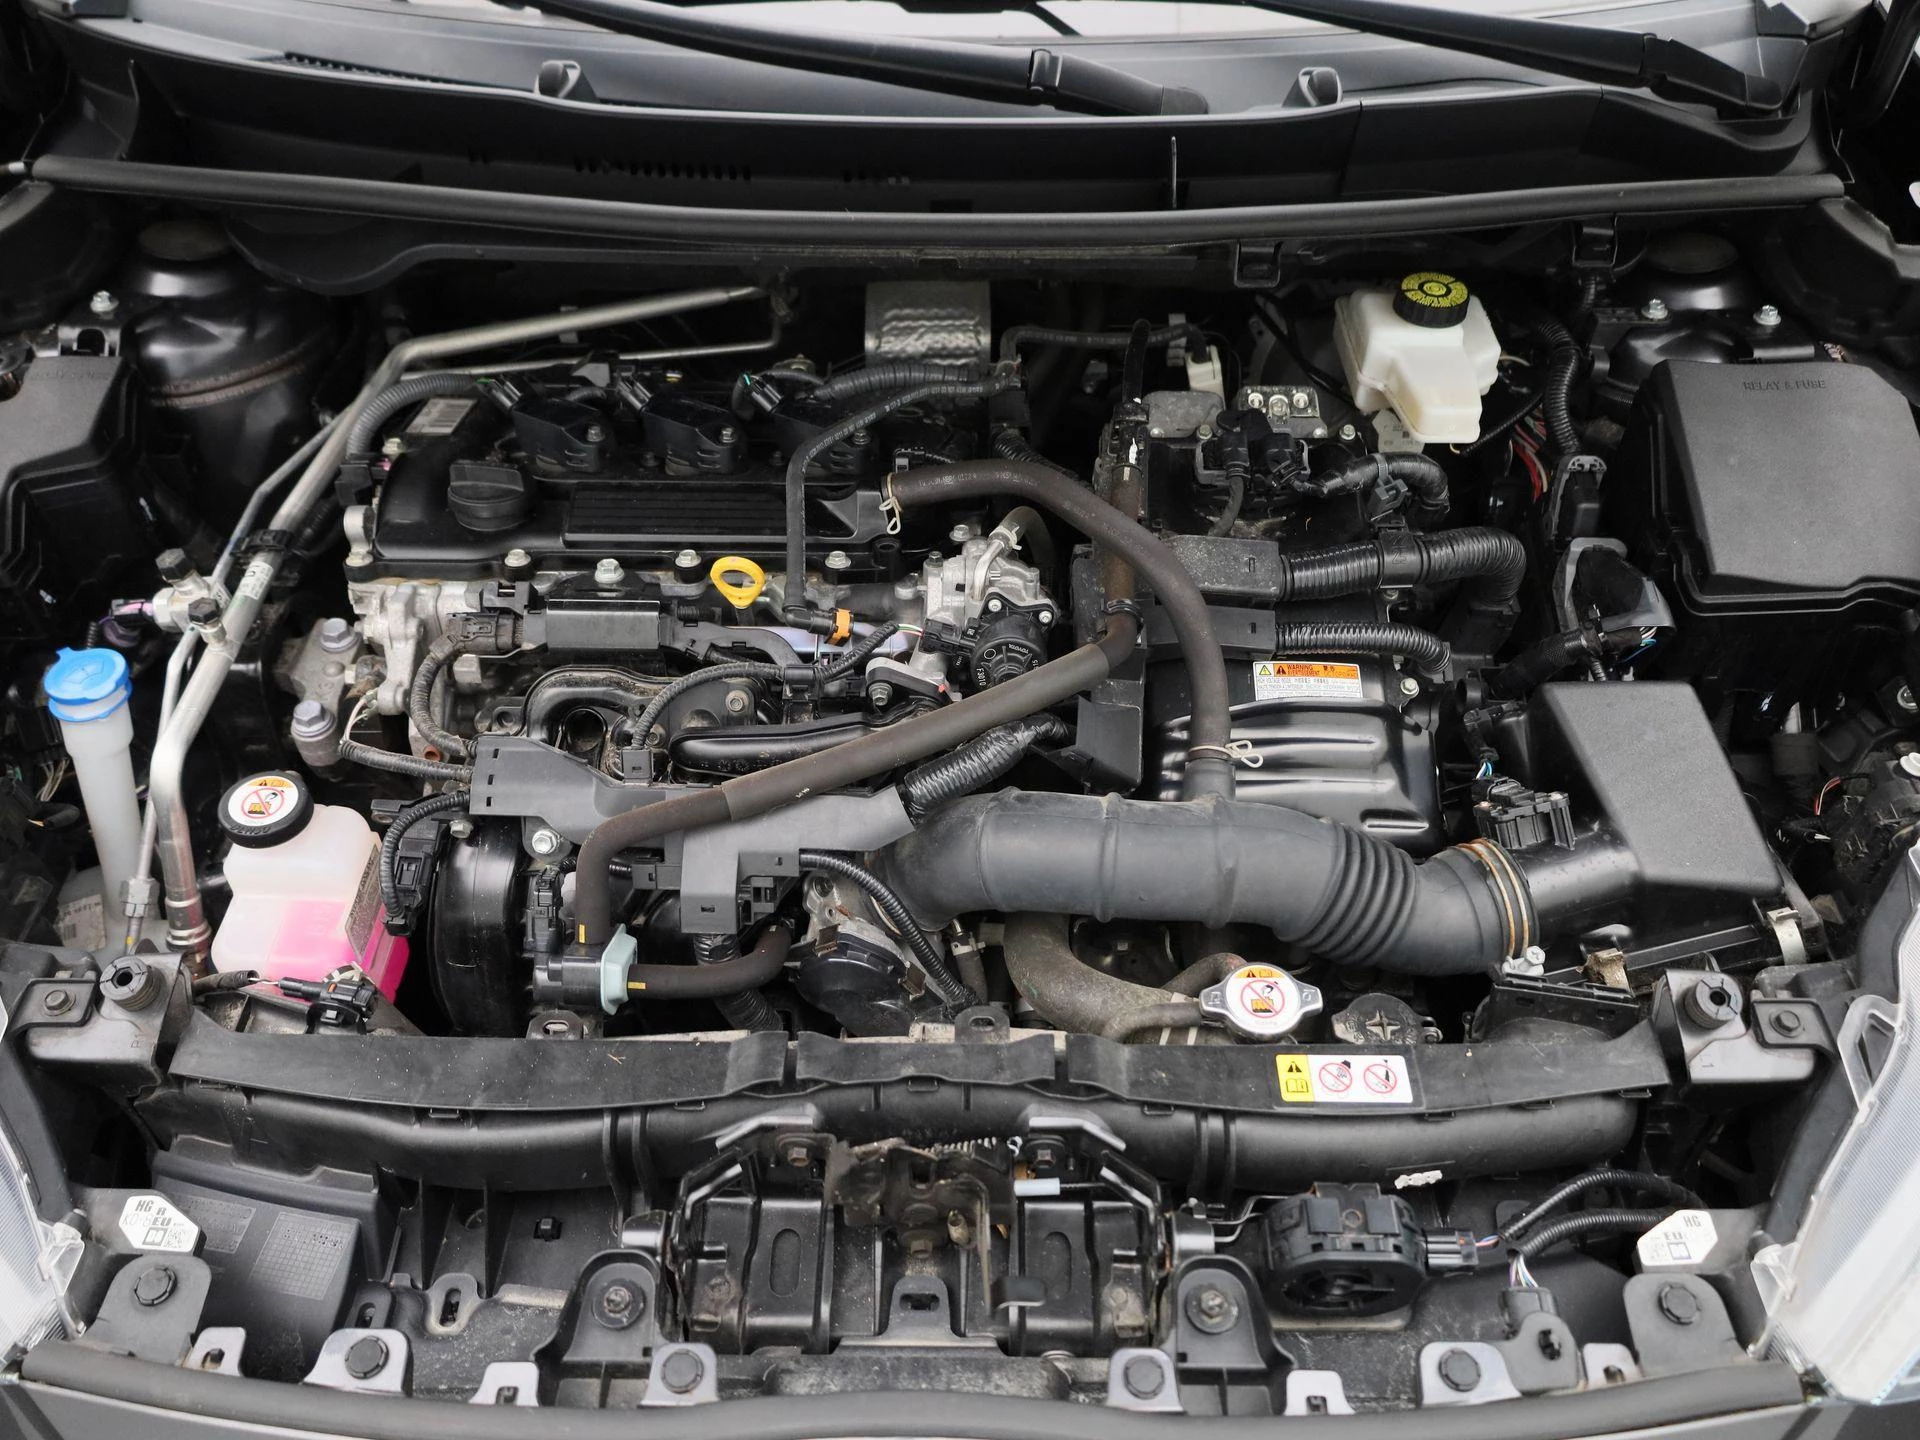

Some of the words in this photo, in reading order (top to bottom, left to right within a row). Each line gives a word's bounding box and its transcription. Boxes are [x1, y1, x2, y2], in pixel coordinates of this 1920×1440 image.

[1743, 381, 1779, 391] RELAY
[1795, 379, 1827, 389] FUSE
[1008, 643, 1029, 654] TOYOTA
